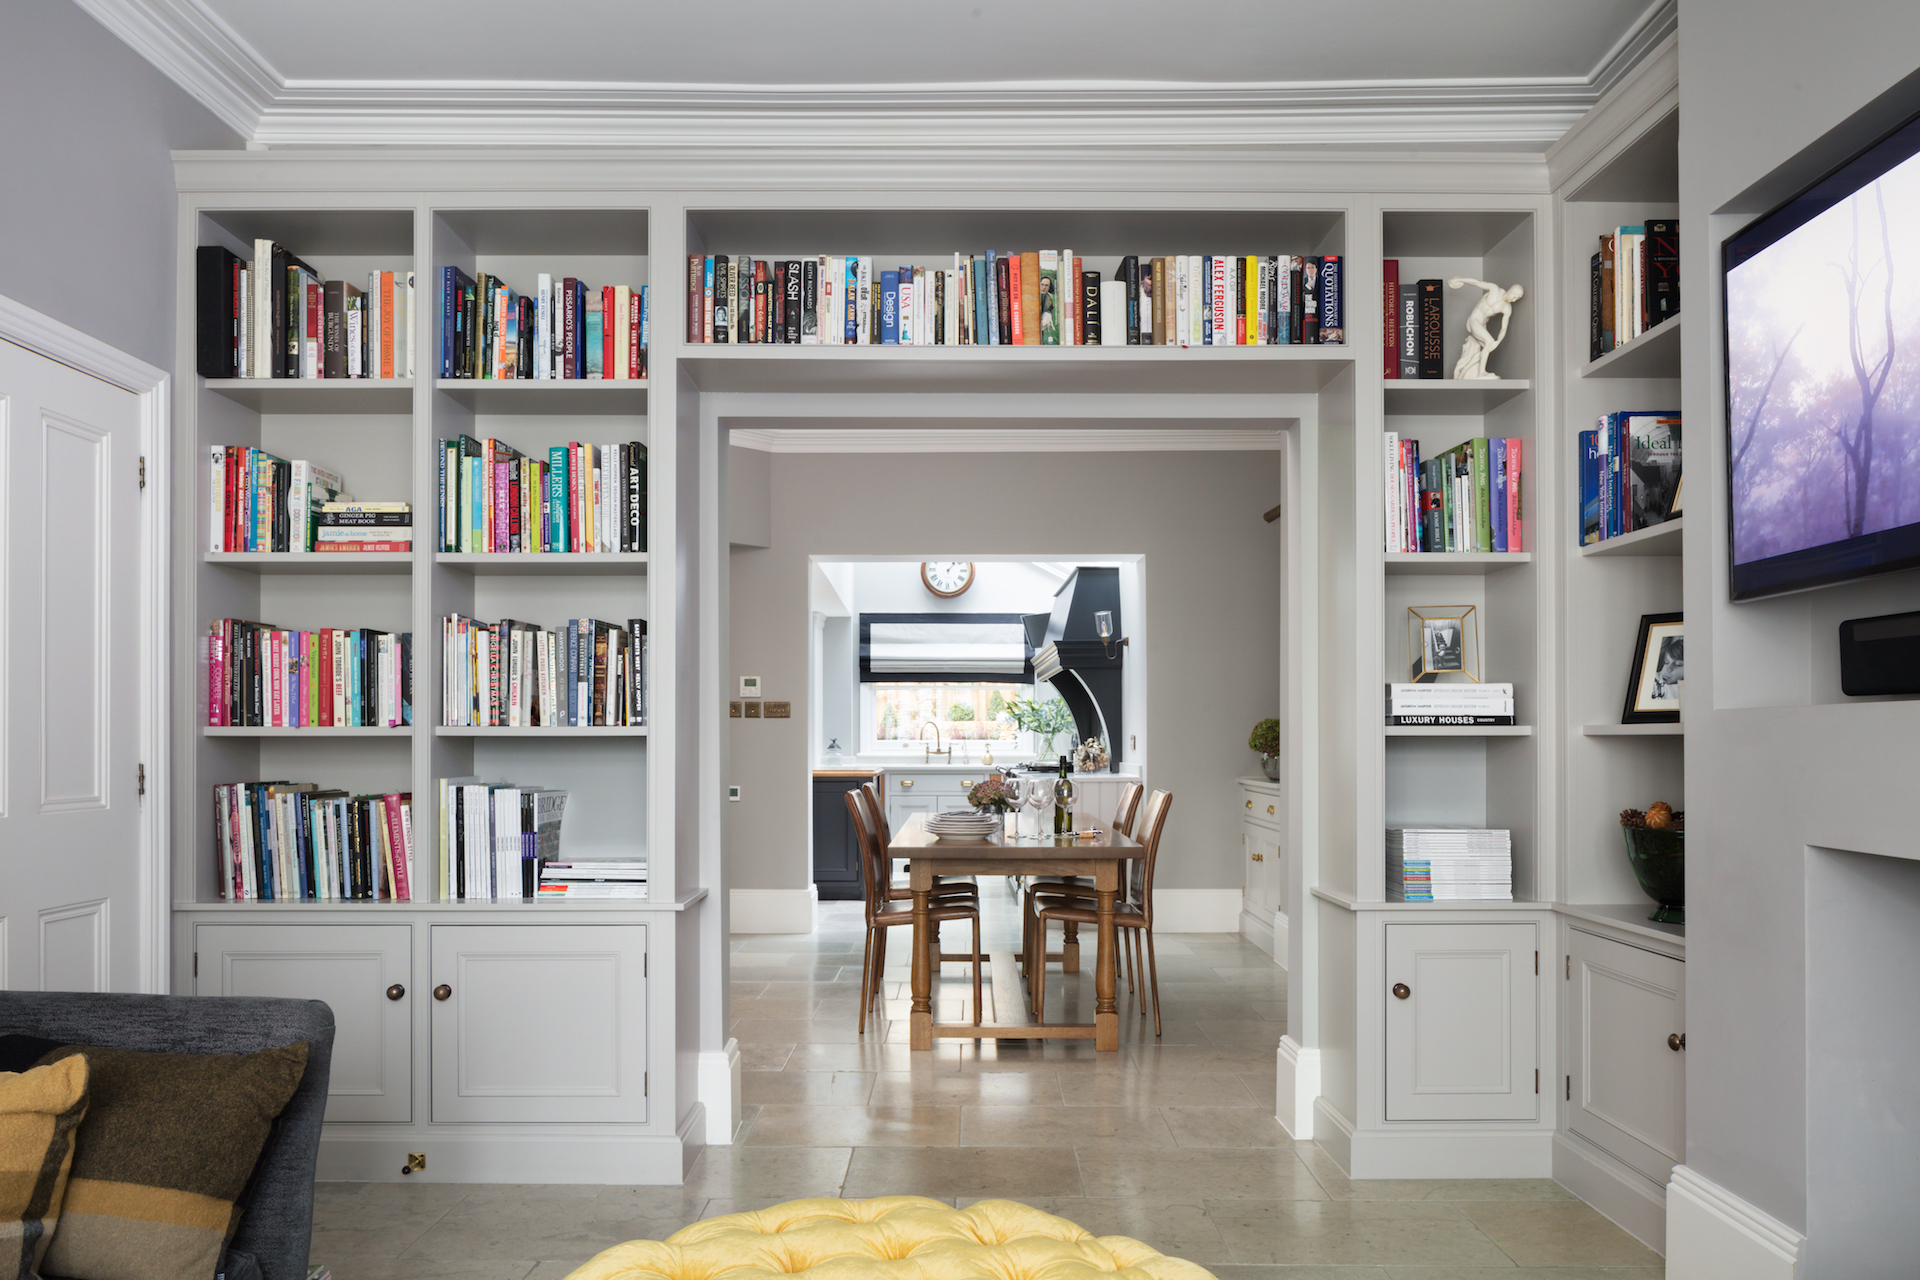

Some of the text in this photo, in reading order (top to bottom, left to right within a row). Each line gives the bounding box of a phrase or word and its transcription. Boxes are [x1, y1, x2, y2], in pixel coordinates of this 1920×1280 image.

[690, 258, 699, 292] PARTRIDGE
[740, 257, 749, 310] NILSSON
[787, 263, 800, 300] SLASH
[1594, 270, 1599, 278] A
[883, 291, 896, 328] Design
[901, 287, 911, 309] USA
[1086, 286, 1100, 326] DALÍ
[1214, 259, 1224, 330] ALEX FERGUSON
[1321, 262, 1334, 327] QUOTATIONS
[349, 311, 359, 343] Wines
[383, 326, 391, 339] OF
[1406, 300, 1414, 356] ROBUCHON
[1429, 298, 1440, 359] LAROUSSE
[334, 344, 340, 352] OF
[1634, 434, 1672, 450] Ideal
[510, 481, 519, 534] LONDON CALLING
[630, 467, 640, 526] ART DECO
[322, 530, 344, 538] jamie
[538, 795, 567, 814] BRIDGE
[391, 818, 400, 854] ELEMENTS
[396, 858, 404, 879] STYLE
